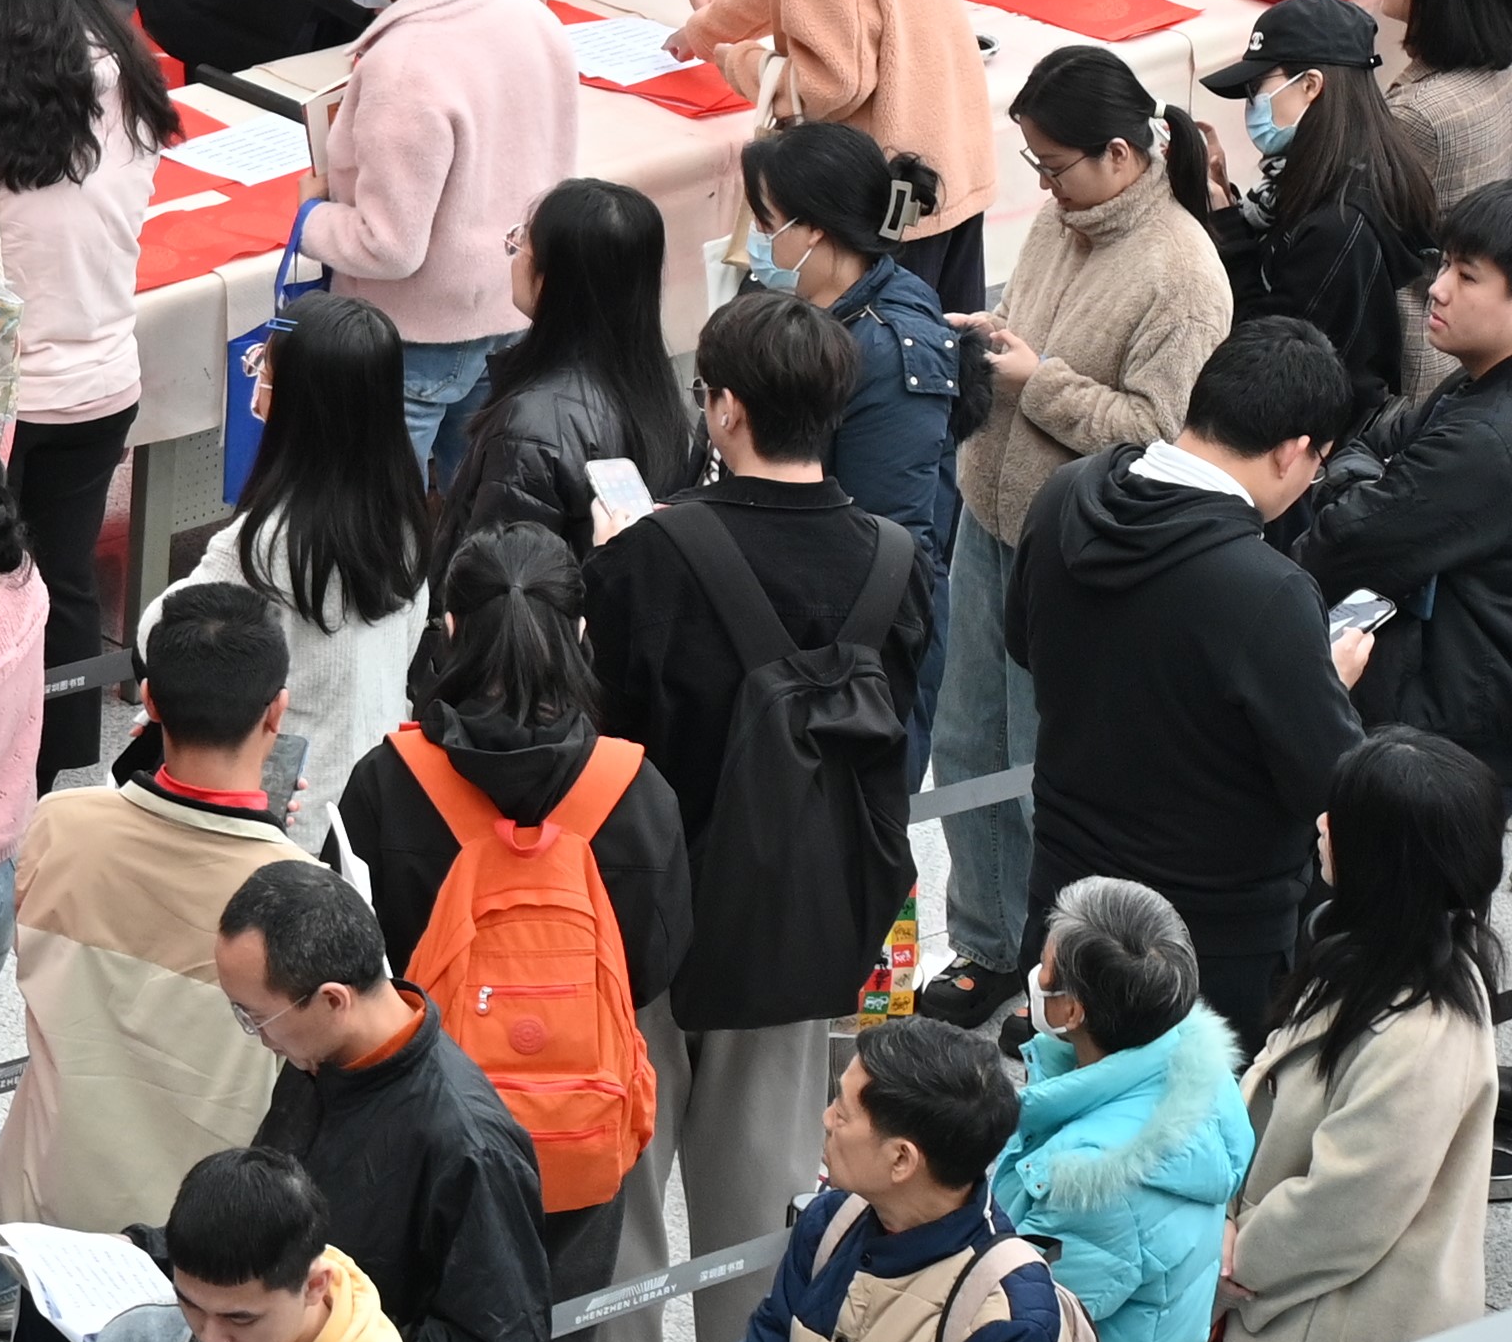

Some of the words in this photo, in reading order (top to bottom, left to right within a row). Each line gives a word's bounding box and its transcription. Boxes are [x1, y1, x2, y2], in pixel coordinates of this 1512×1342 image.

[699, 1259, 745, 1283] 深圳图书馆
[575, 1299, 631, 1325] SHENZHEN
[633, 1283, 677, 1306] LIBRARY
